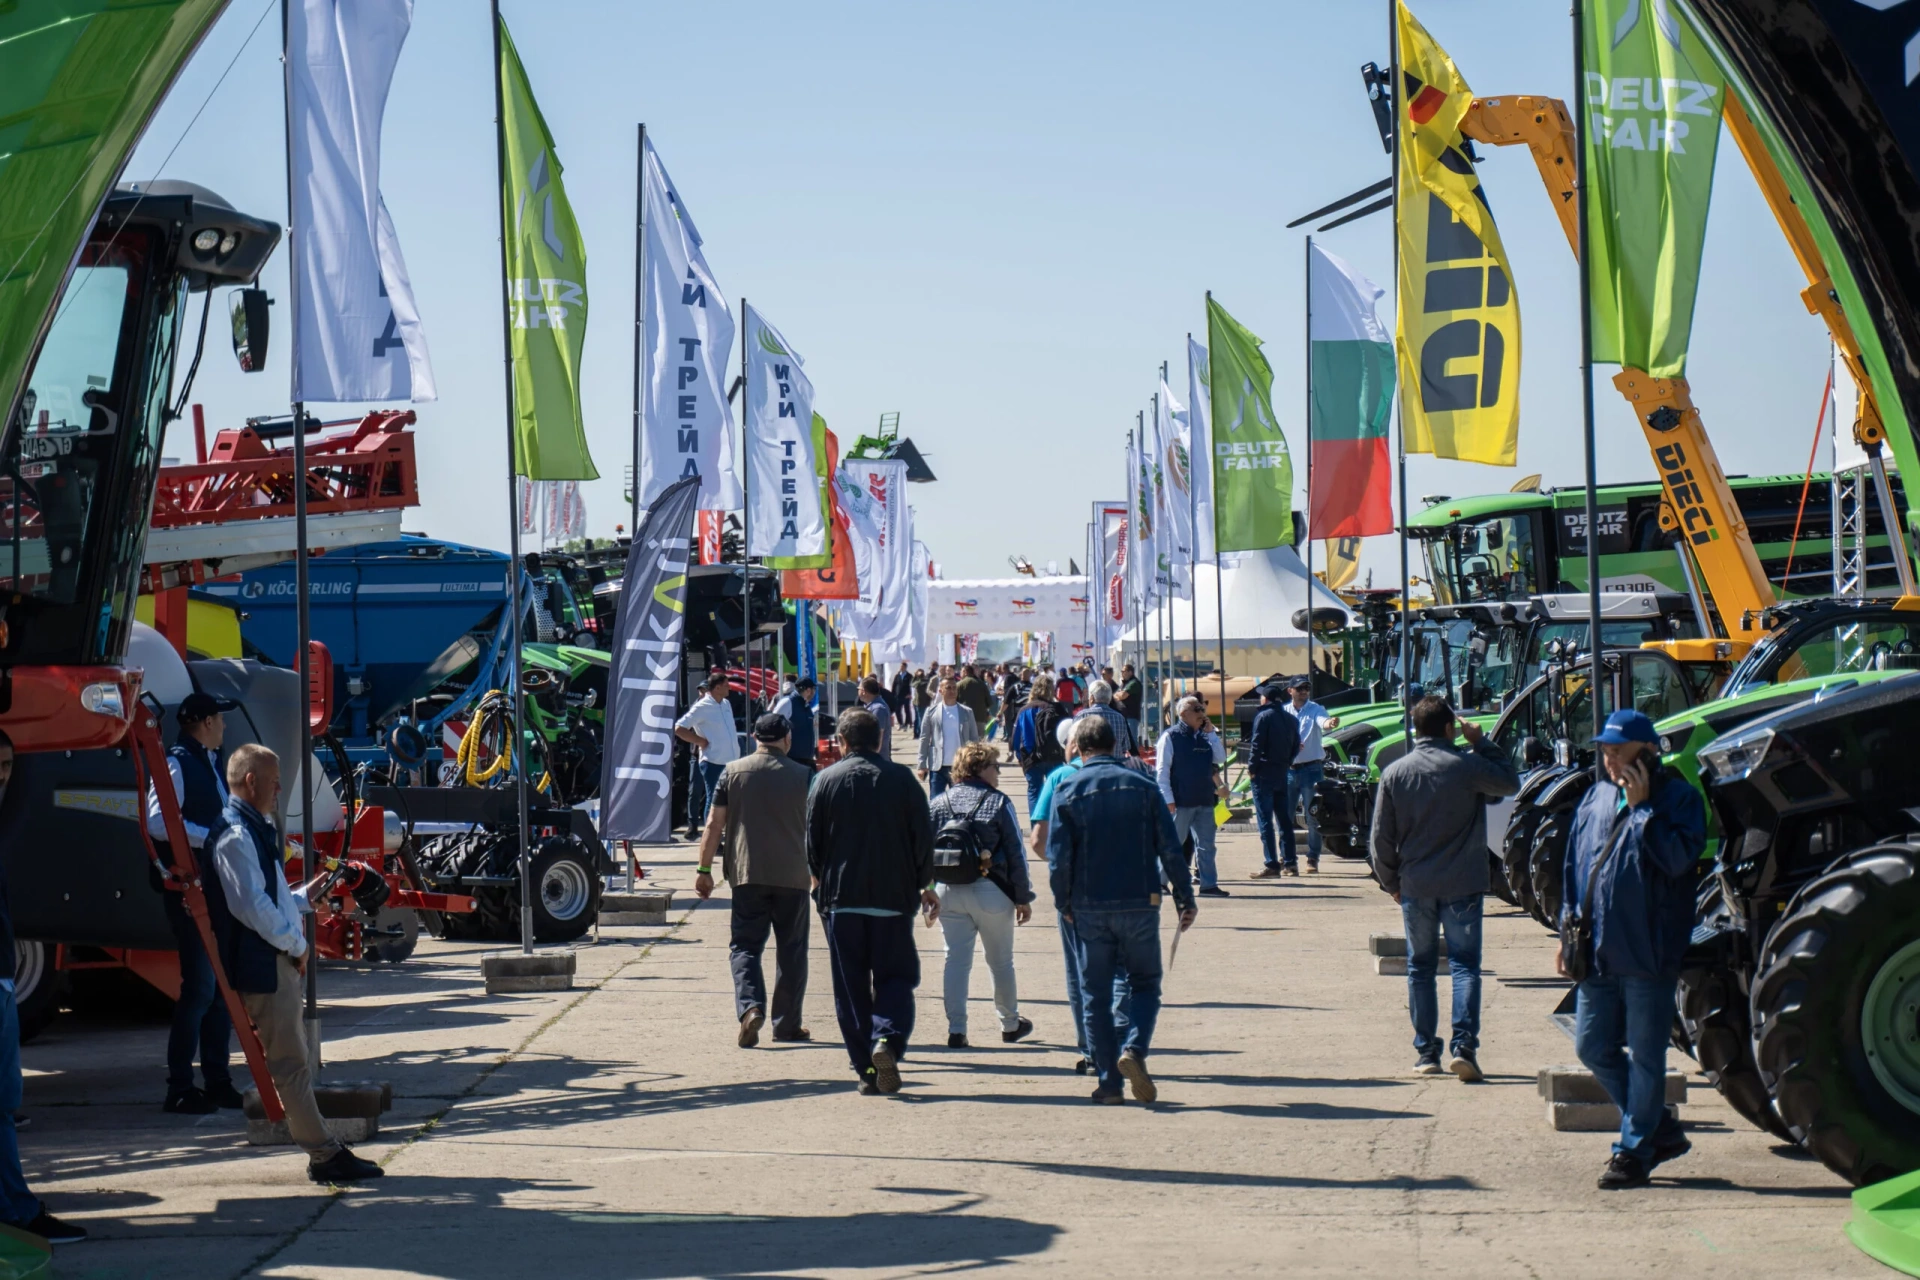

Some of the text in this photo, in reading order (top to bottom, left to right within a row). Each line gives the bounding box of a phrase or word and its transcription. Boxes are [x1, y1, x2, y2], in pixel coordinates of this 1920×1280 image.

[1592, 112, 1687, 154] FAHR
[774, 364, 799, 540] ИРИ ТРЕЙД
[1216, 440, 1288, 456] DEUTZ
[1223, 455, 1282, 470] FAHR
[1655, 442, 1719, 546] DIECI
[443, 583, 477, 592] ULTIMA
